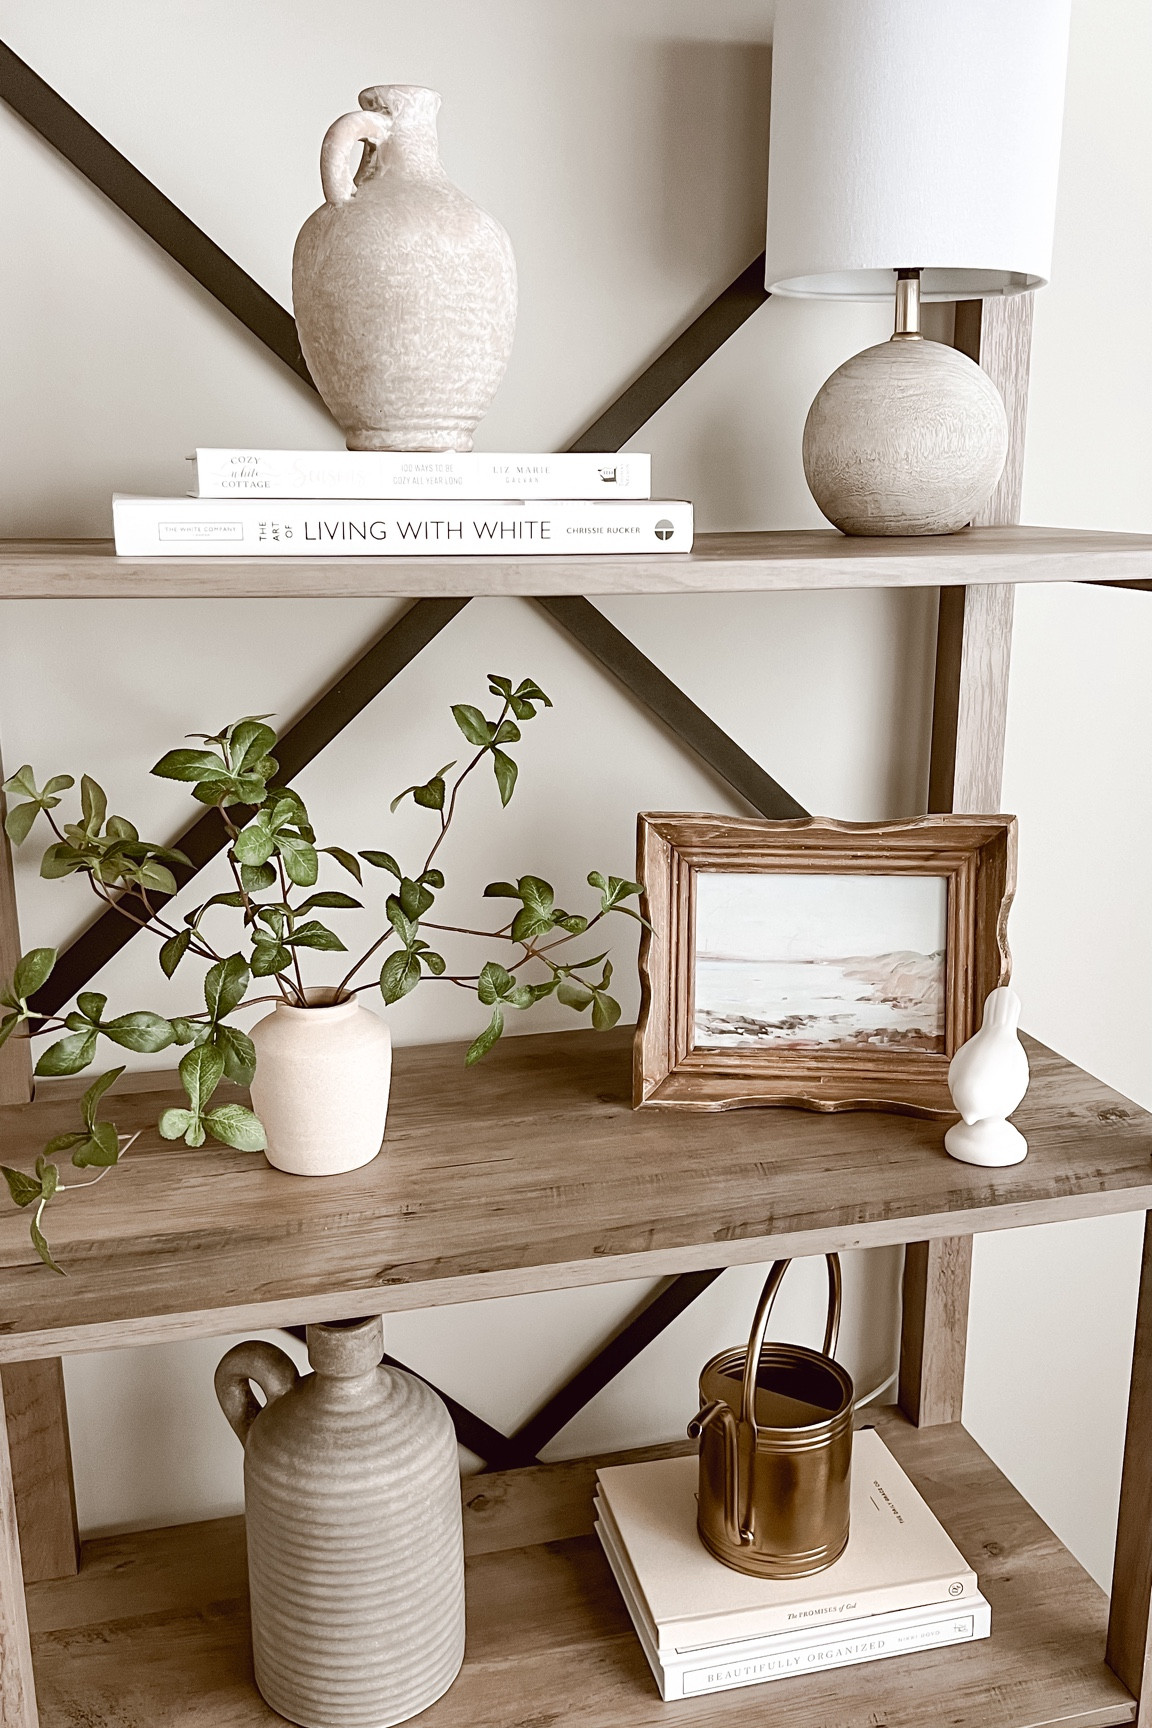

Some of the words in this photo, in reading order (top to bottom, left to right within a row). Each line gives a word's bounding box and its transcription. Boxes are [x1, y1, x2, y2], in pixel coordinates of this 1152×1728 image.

[230, 456, 261, 465] COZY
[401, 464, 414, 473] 100
[415, 464, 433, 473] WAYS
[434, 464, 444, 473] TO
[445, 464, 454, 473] BE
[493, 466, 510, 474] LIZ
[517, 466, 550, 474] MARIE
[221, 480, 271, 489] COTTAGE
[392, 476, 410, 485] COZY
[412, 477, 424, 486] ALL
[426, 477, 443, 486] YEAR
[444, 477, 463, 486] LONG
[258, 521, 268, 542] THE
[271, 521, 281, 542] ART
[284, 524, 294, 539] OF
[304, 520, 387, 541] LIVING
[396, 520, 463, 540] WITH
[472, 520, 551, 540] WHITE
[566, 527, 604, 535] CHRISSIE
[606, 526, 641, 534] RUCKER
[787, 1612, 798, 1620] The
[799, 1606, 837, 1618] PROMISES
[839, 1604, 845, 1612] of
[846, 1602, 857, 1610] God
[707, 1657, 801, 1683] BEAUTIFULLY
[807, 1640, 886, 1662] ORGANIZED
